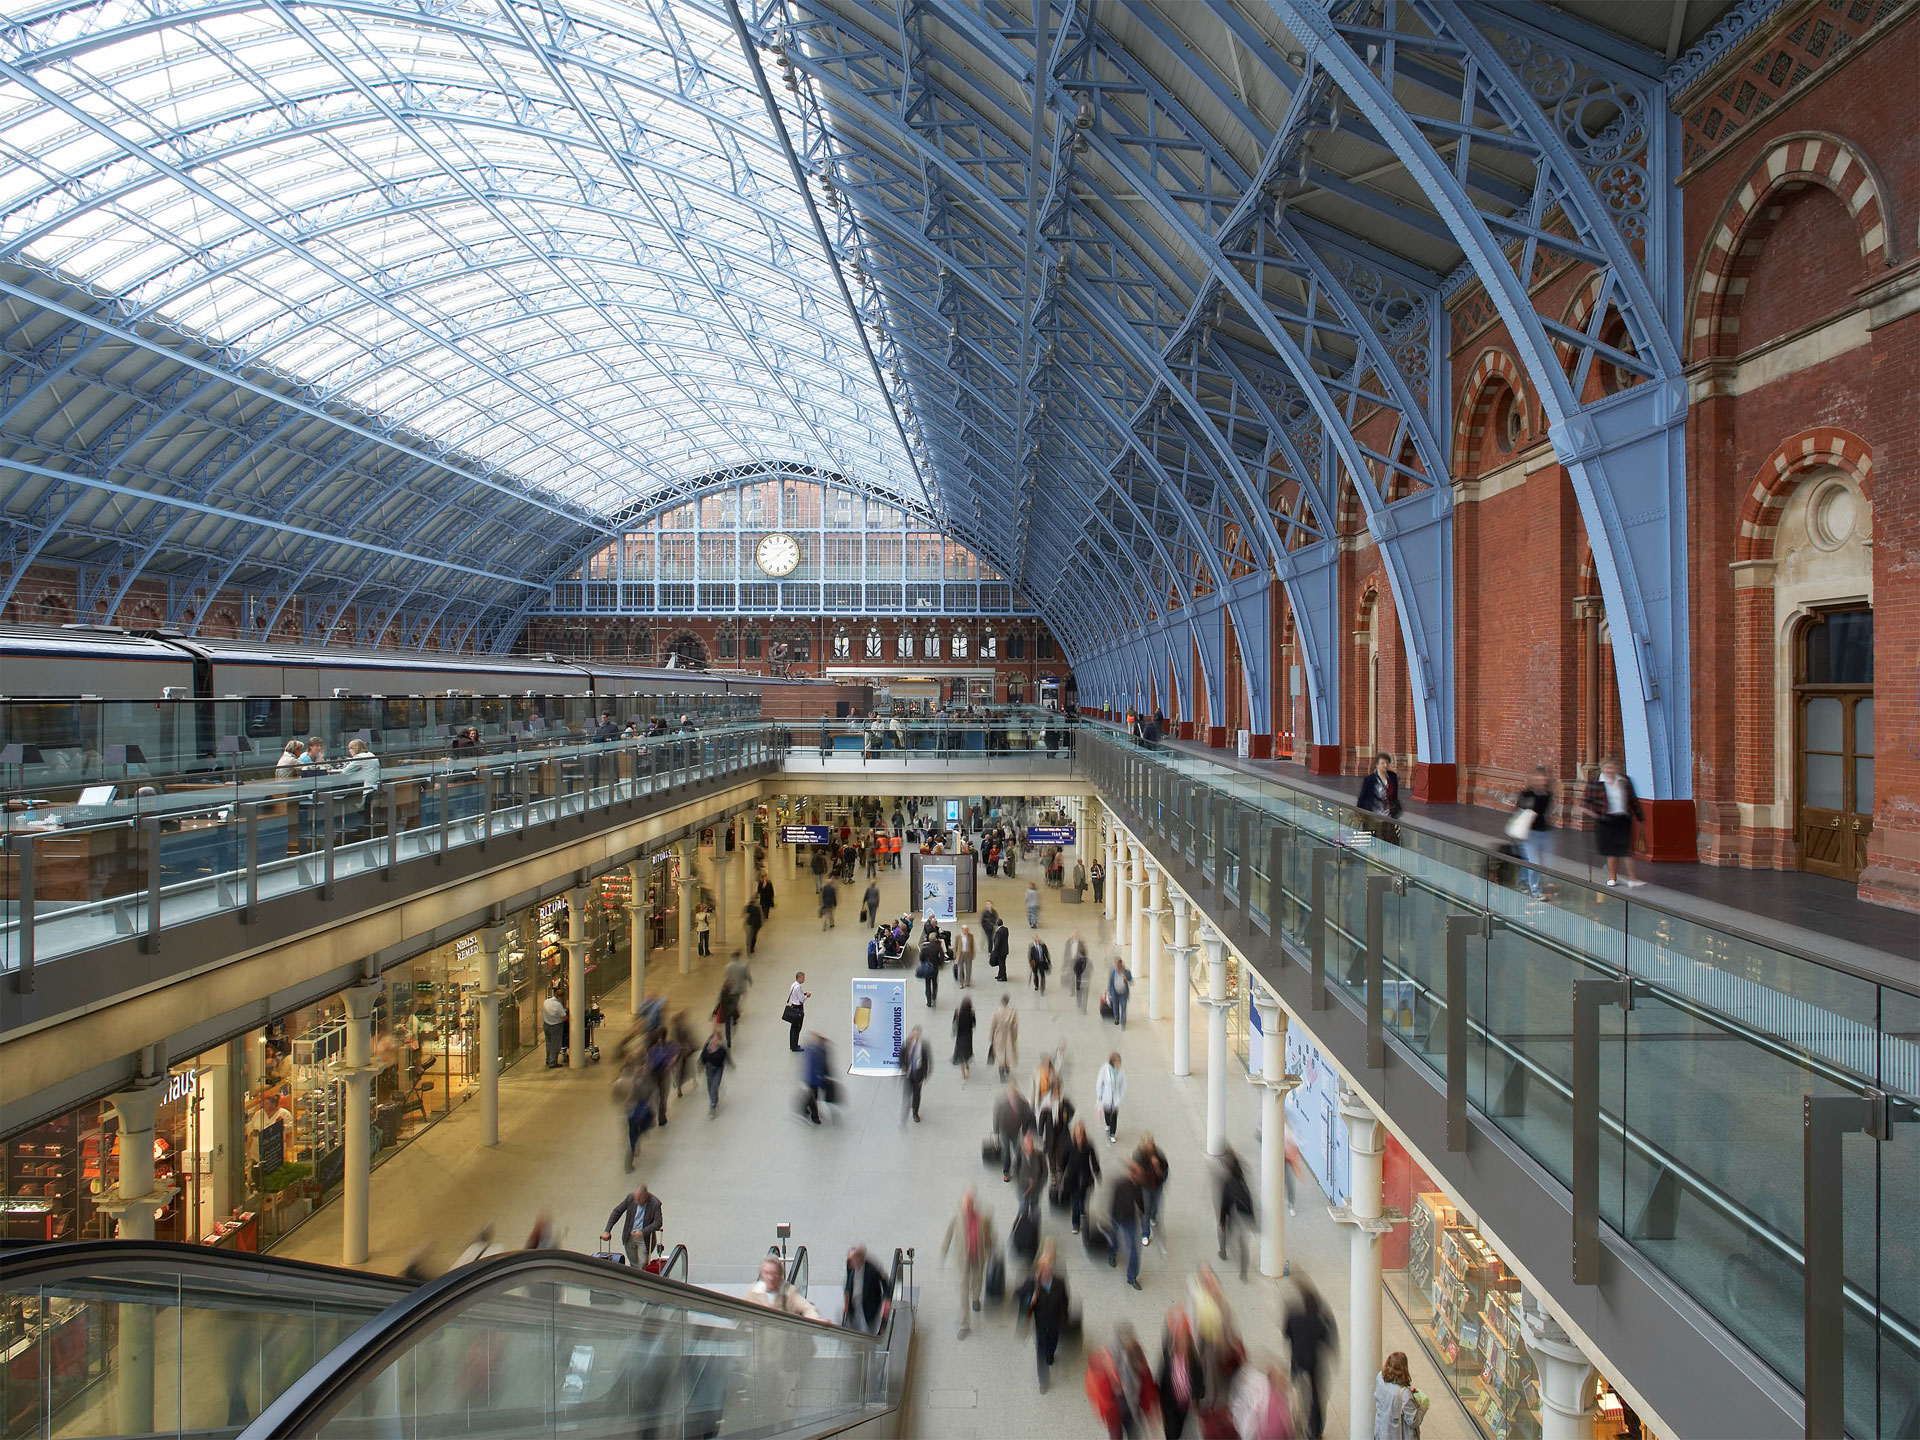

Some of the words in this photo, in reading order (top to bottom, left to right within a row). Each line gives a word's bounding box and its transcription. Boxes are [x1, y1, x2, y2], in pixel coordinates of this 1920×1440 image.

[652, 849, 671, 864] RITUALS
[539, 898, 569, 920] RITUAL
[457, 945, 479, 961] REMED
[892, 1006, 902, 1058] Rendezvous
